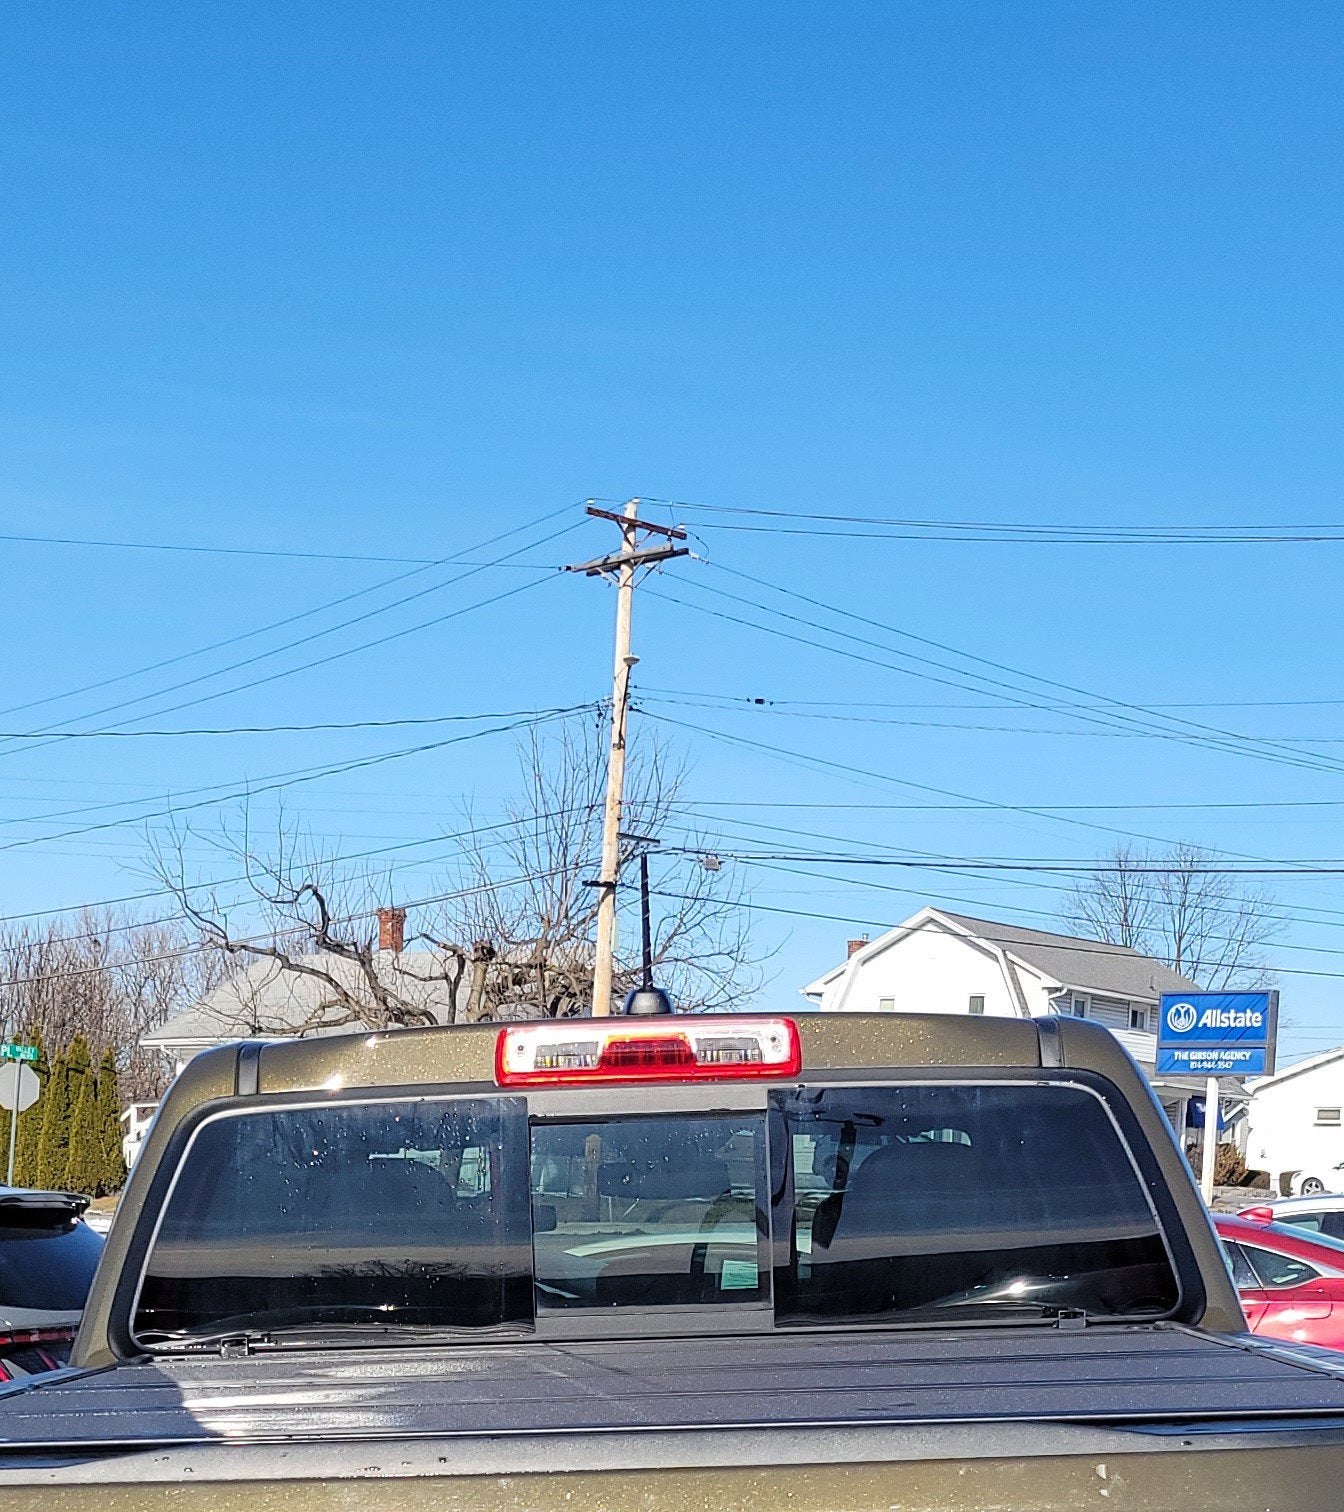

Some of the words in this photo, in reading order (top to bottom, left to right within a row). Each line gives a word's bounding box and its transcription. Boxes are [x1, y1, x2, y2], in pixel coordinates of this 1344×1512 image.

[1198, 1008, 1263, 1028] Allstate
[1174, 1051, 1188, 1060] THE
[1219, 1051, 1251, 1060] AGENCY
